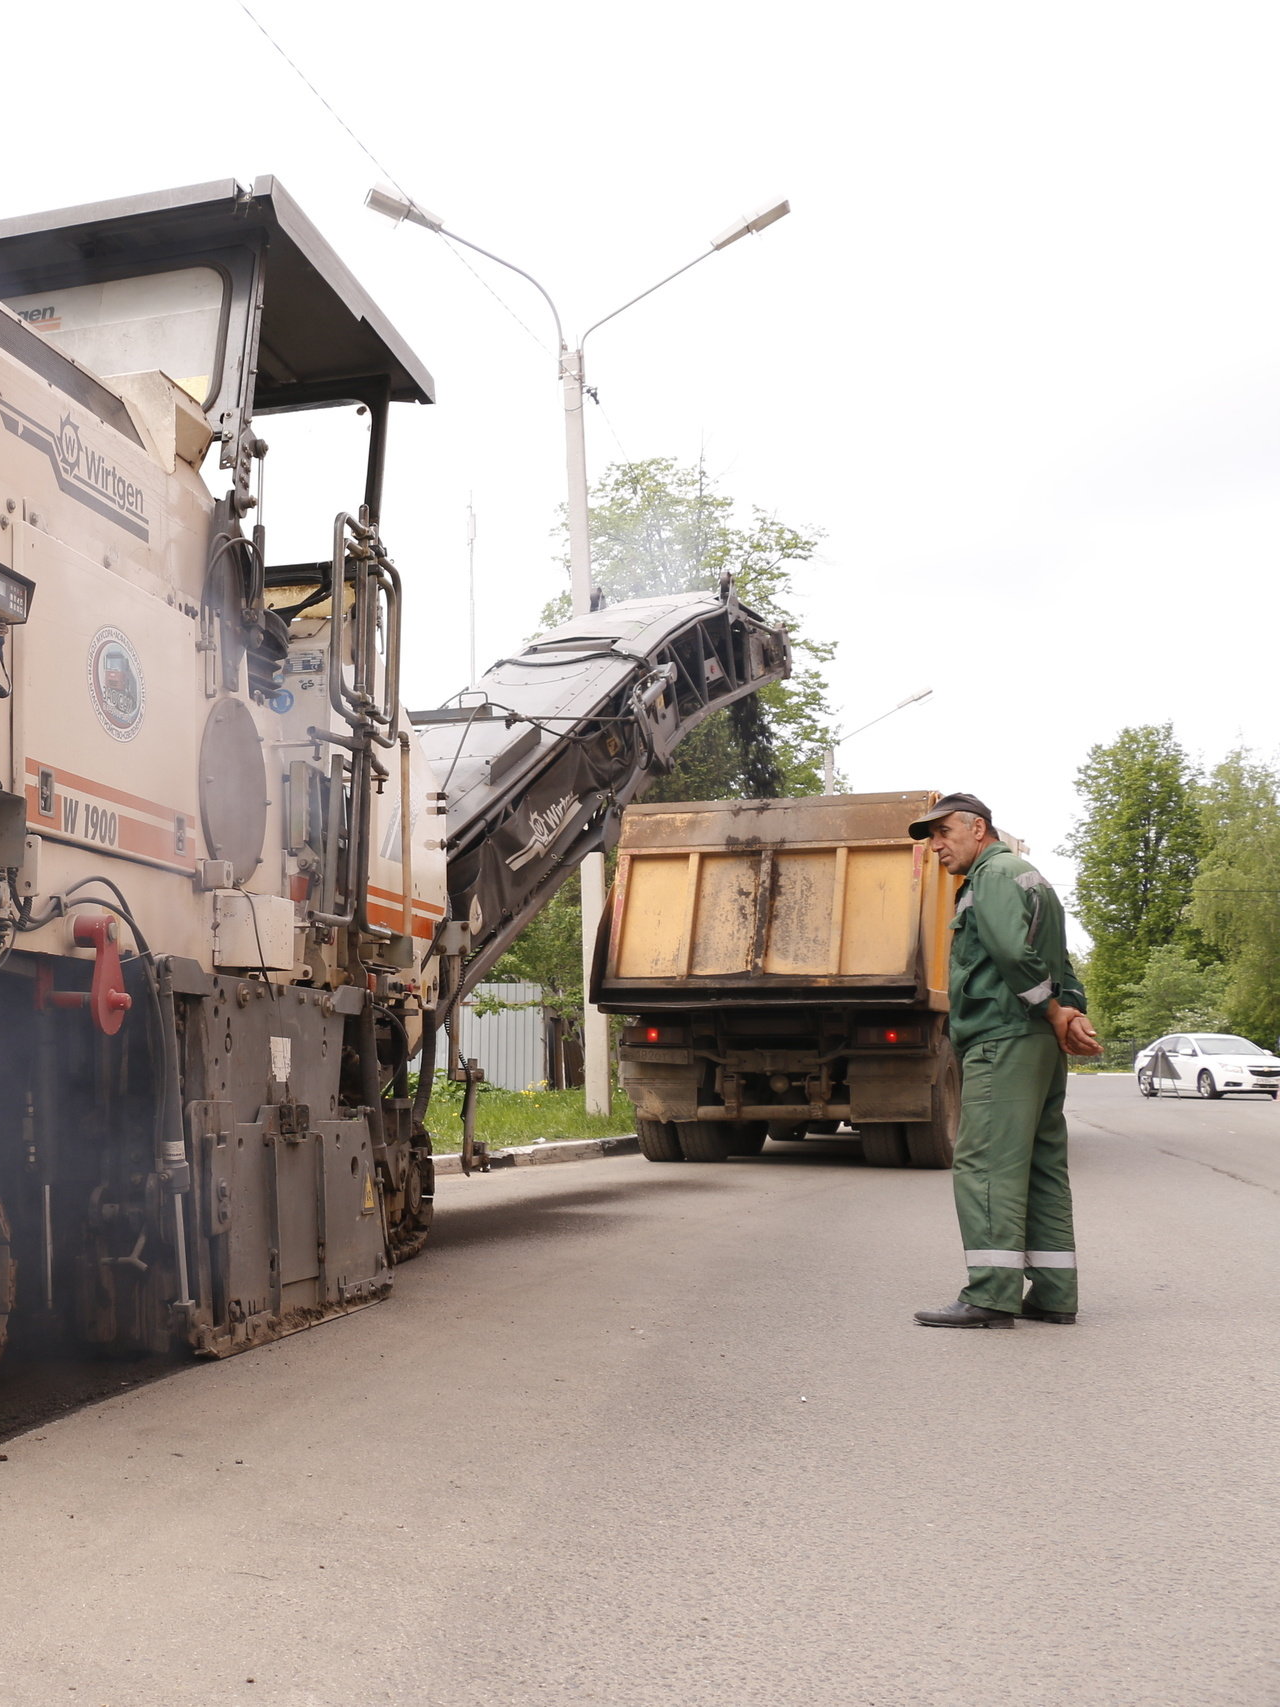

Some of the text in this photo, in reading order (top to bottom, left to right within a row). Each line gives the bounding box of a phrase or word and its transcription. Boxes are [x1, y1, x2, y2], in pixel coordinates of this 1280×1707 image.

[85, 445, 144, 514] Wirtgen
[63, 796, 117, 846] W 1900
[542, 790, 574, 830] Wirt
